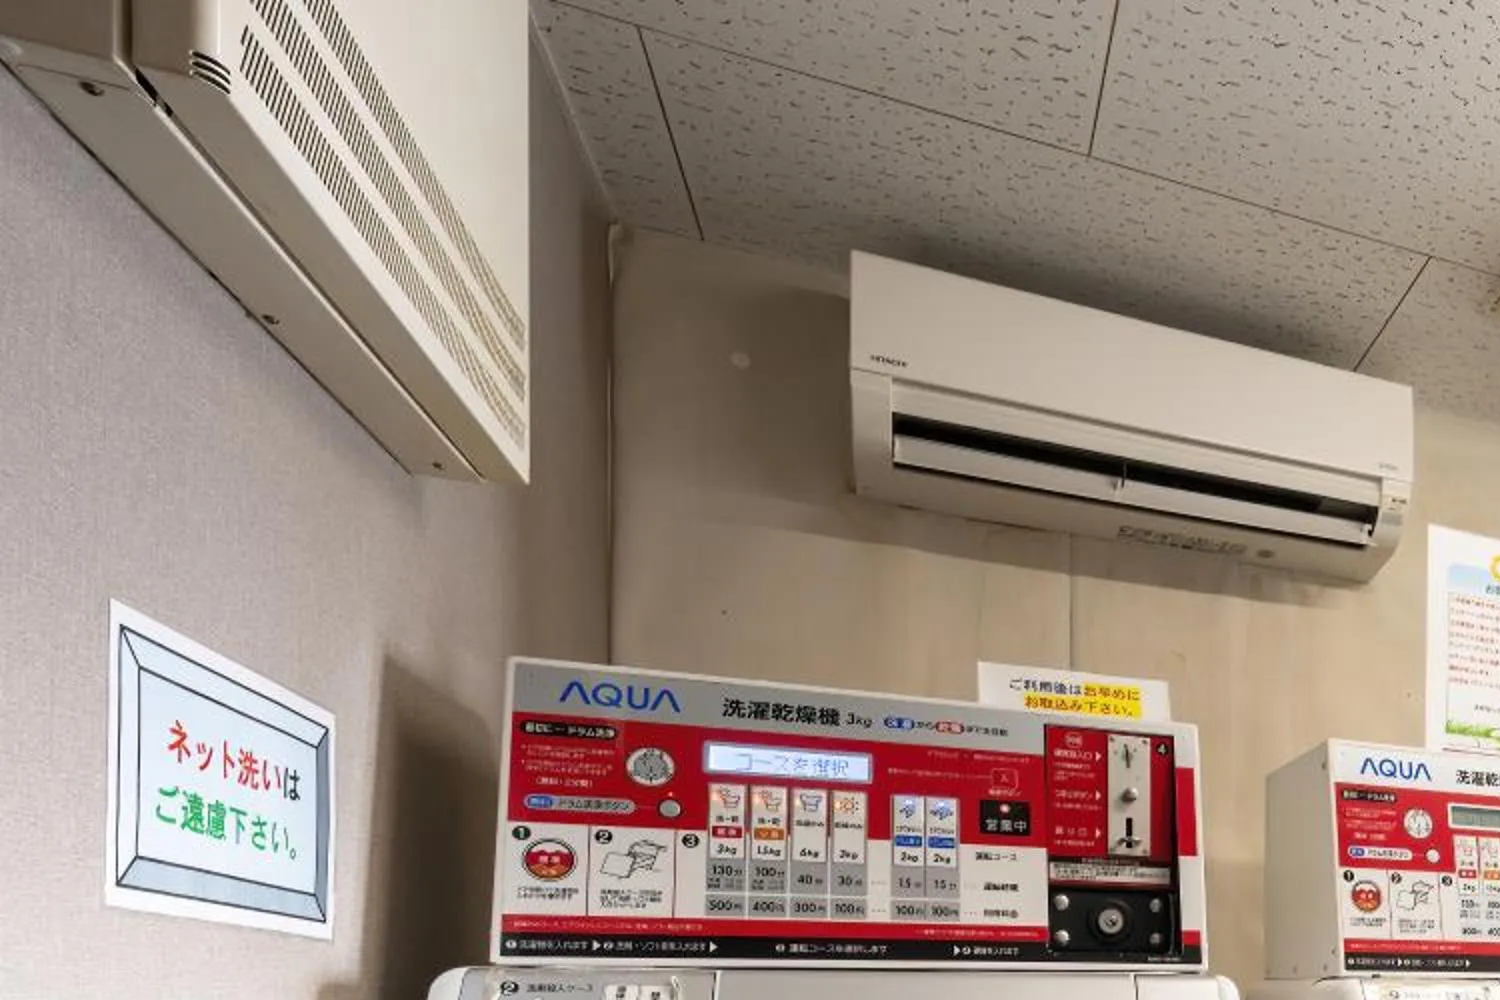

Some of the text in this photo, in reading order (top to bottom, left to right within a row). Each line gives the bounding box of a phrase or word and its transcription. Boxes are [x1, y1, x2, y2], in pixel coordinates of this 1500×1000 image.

[560, 680, 681, 714] AQUA
[722, 697, 841, 727] 洗濯乾燥機
[167, 719, 301, 801] ネット洗いは
[1360, 756, 1432, 781] AQUA
[155, 785, 297, 861] ご遠慮下さい。
